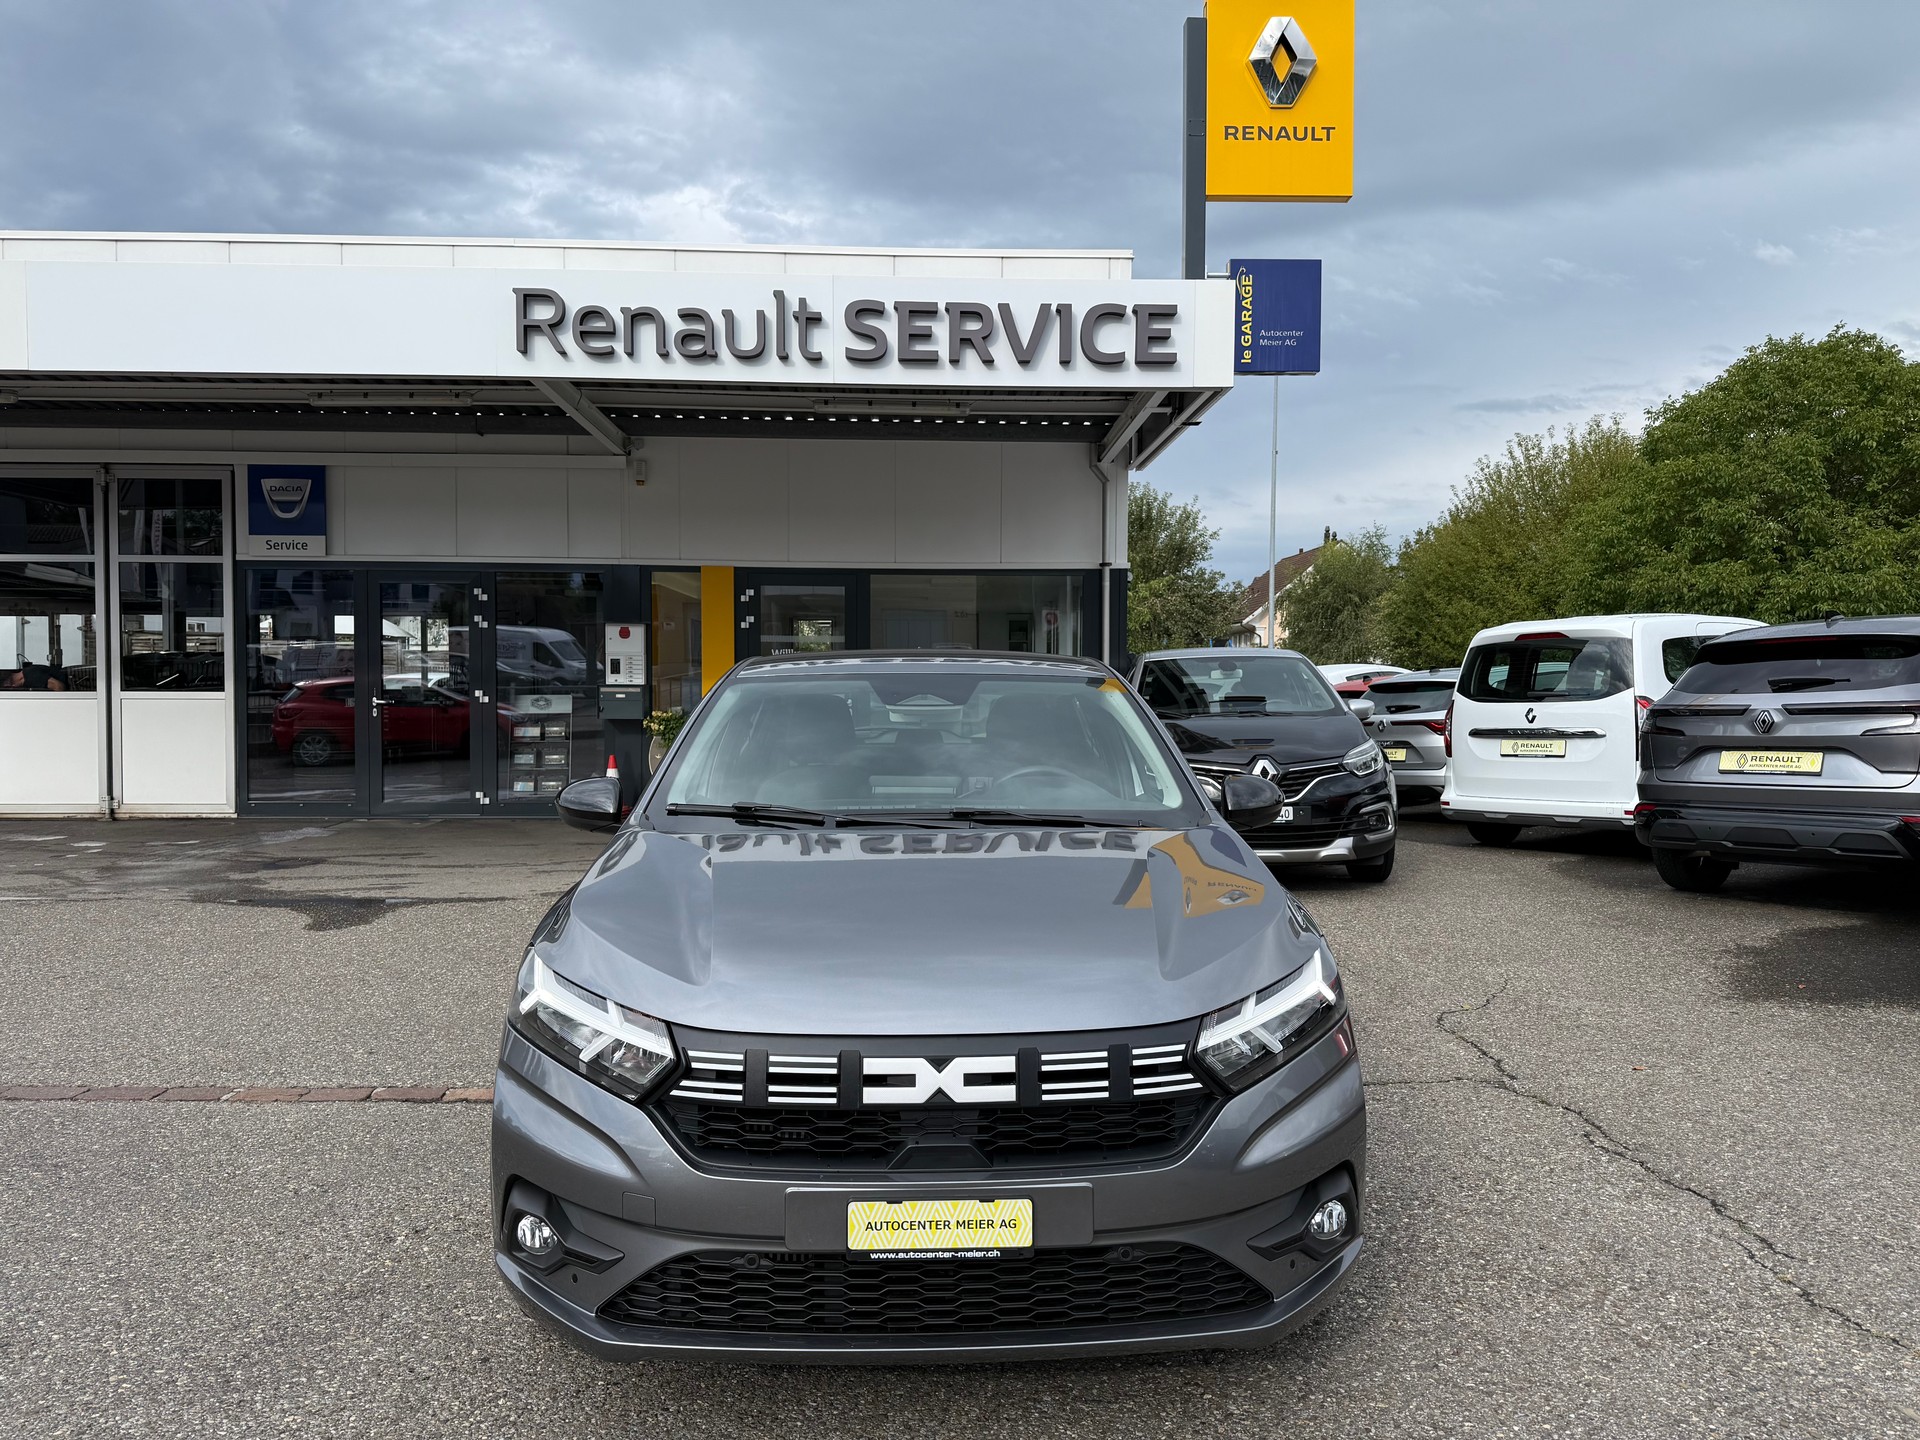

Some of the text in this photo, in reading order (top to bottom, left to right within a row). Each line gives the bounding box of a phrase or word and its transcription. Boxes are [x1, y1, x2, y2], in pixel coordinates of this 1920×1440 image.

[1224, 125, 1336, 141] RENAULT
[1241, 274, 1252, 363] le GARAGE
[512, 287, 1178, 366] Renault SERVICE
[1259, 329, 1304, 337] Autocenter
[265, 539, 308, 550] Service
[865, 1218, 1017, 1232] AUTOCENTER MEIER AG
[870, 1250, 1001, 1260] www.autocenter-meier.ch
